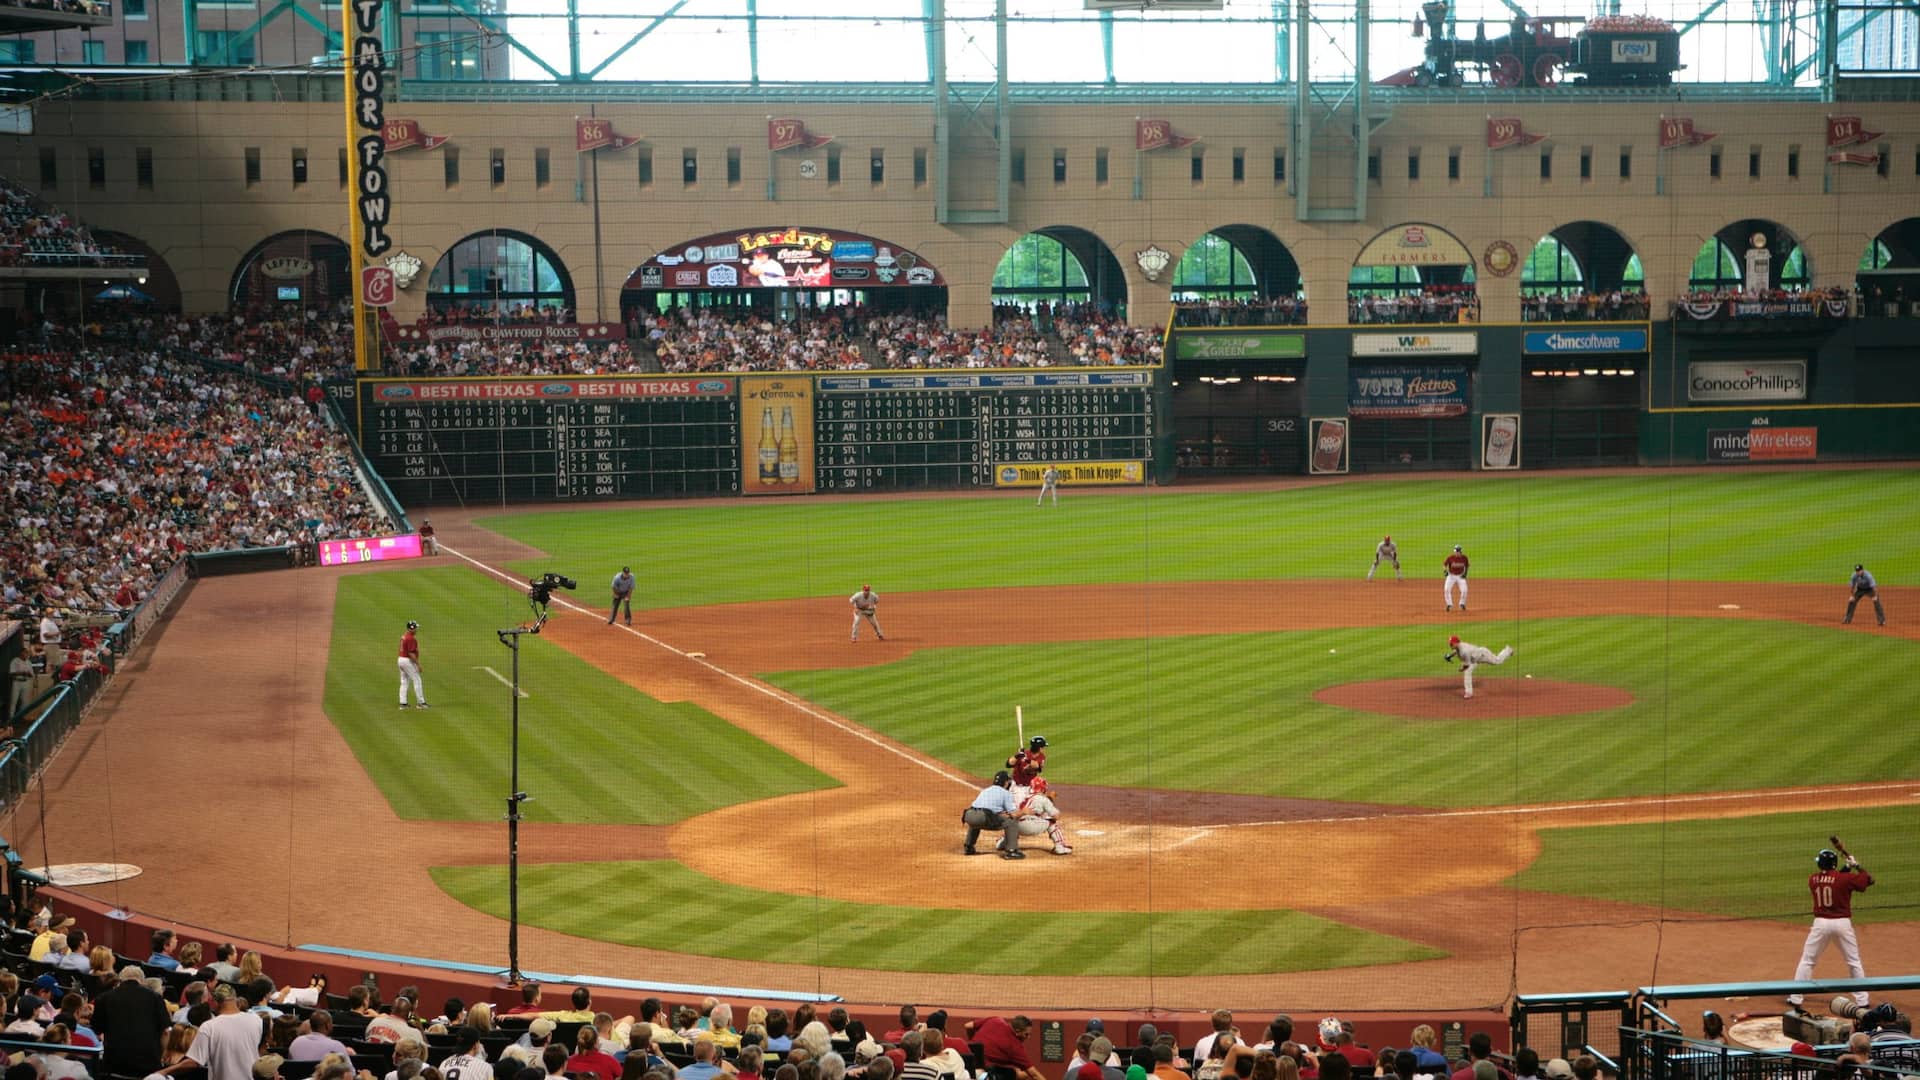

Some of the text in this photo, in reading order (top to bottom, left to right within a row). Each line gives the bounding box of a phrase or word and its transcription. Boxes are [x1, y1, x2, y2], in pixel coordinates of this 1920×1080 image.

[360, 43, 378, 125] MOR
[388, 126, 407, 141] 80
[584, 126, 602, 141] 86
[776, 126, 796, 140] 97
[1144, 126, 1163, 140] 98
[1496, 123, 1514, 138] 99
[1667, 125, 1686, 139] 01
[1835, 124, 1854, 138] 04
[364, 142, 386, 250] FOWL
[740, 230, 832, 252] Landry's
[266, 257, 308, 270] LEFTY'S
[482, 327, 542, 338] CRAWFORD
[546, 326, 579, 337] BOXES
[1398, 336, 1430, 346] WM
[1556, 335, 1620, 350] bmcsoftware
[1210, 347, 1245, 355] GREEN
[420, 384, 535, 397] BEST IN TEXAS
[579, 382, 690, 395] BEST IN TEXAS
[1358, 376, 1457, 398] VOTE Astros
[1692, 376, 1801, 392] ConocoPhillips
[328, 386, 354, 398] 315
[760, 391, 794, 400] Corona
[405, 409, 422, 417] BAL
[410, 420, 420, 428] TB
[1268, 421, 1295, 431] 362
[408, 444, 422, 452] CLE
[558, 416, 567, 486] AMERICAN
[406, 457, 424, 465] LAA
[1017, 452, 1033, 460] COL
[406, 468, 425, 476] CWS
[1020, 468, 1040, 481] Think
[1075, 467, 1094, 480] Think
[1097, 466, 1122, 481] Kroger
[596, 476, 612, 484] BOS
[596, 487, 613, 495] OAK
[359, 548, 371, 562] 10
[1815, 886, 1832, 907] 10
[444, 1056, 472, 1067] PENCE
